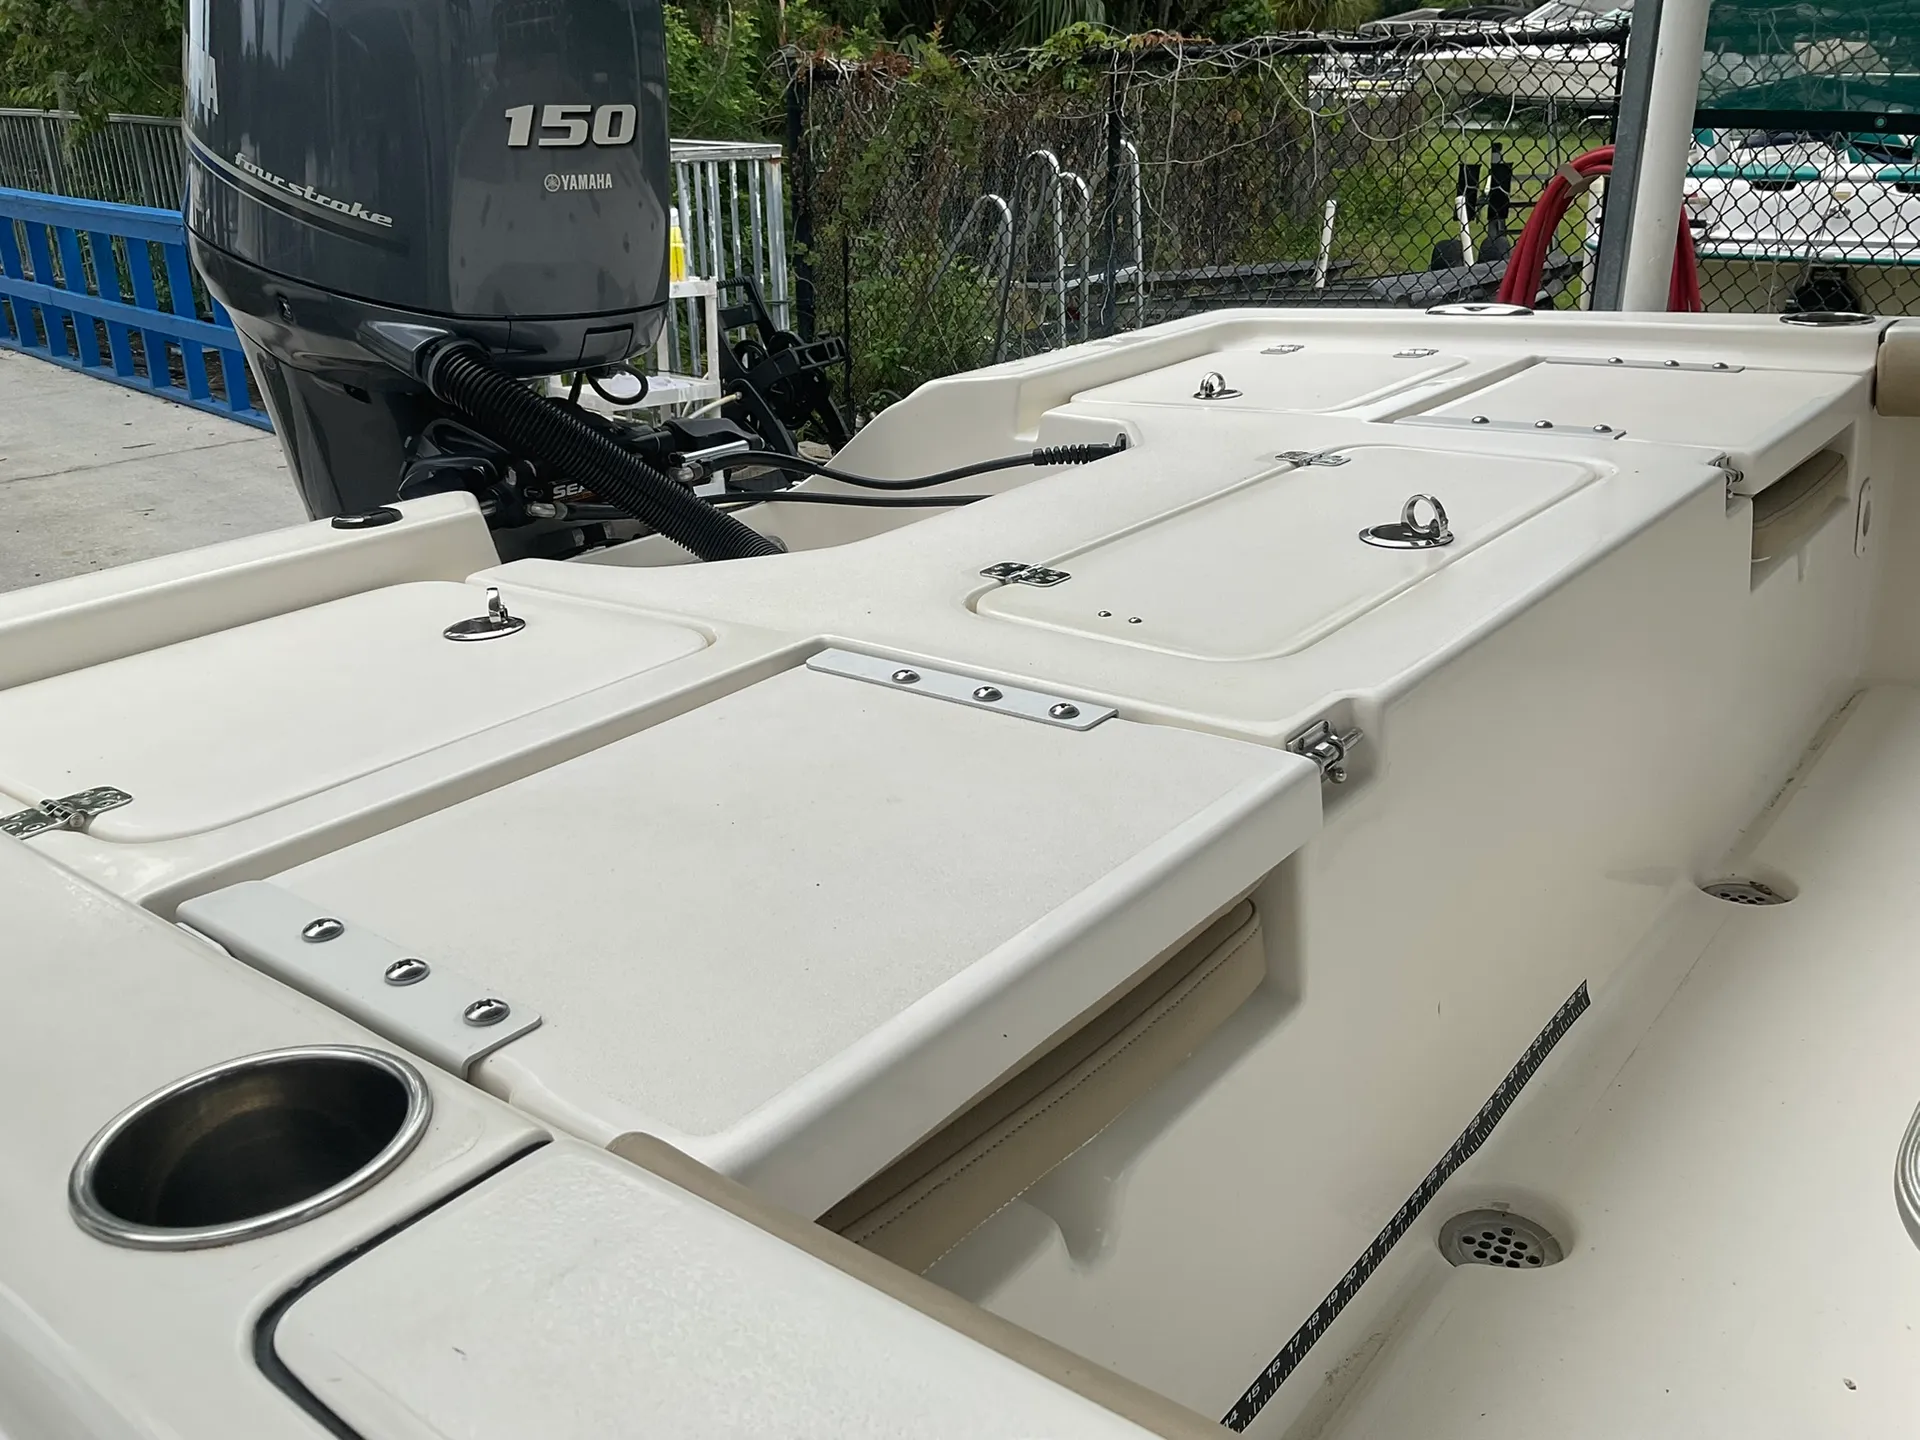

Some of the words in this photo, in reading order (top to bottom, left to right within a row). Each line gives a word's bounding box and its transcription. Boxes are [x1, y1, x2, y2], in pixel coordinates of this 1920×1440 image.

[505, 104, 637, 147] 150
[561, 173, 613, 191] YAMAHA
[1223, 1409, 1239, 1428] 14
[1245, 1382, 1261, 1403] 15
[1266, 1358, 1281, 1378] 16
[1287, 1333, 1301, 1353] 17
[1306, 1311, 1320, 1330] 18
[1325, 1289, 1339, 1307] 19
[1343, 1267, 1357, 1289] 20
[1361, 1246, 1374, 1267] 21
[1379, 1224, 1392, 1246] 22
[1394, 1205, 1408, 1226] 23
[1410, 1186, 1423, 1206] 24
[1425, 1169, 1437, 1188] 25
[1440, 1151, 1452, 1170] 26
[1455, 1133, 1466, 1152] 27
[1468, 1117, 1480, 1135] 28
[1482, 1100, 1493, 1117] 29
[1495, 1082, 1506, 1099] 30
[1508, 1067, 1518, 1082] 31
[1520, 1050, 1530, 1066] 32
[1532, 1035, 1542, 1050] 33
[1544, 1022, 1553, 1036] 34
[1555, 1007, 1565, 1022] 35
[1566, 996, 1576, 1009] 36
[1577, 984, 1586, 997] 37
